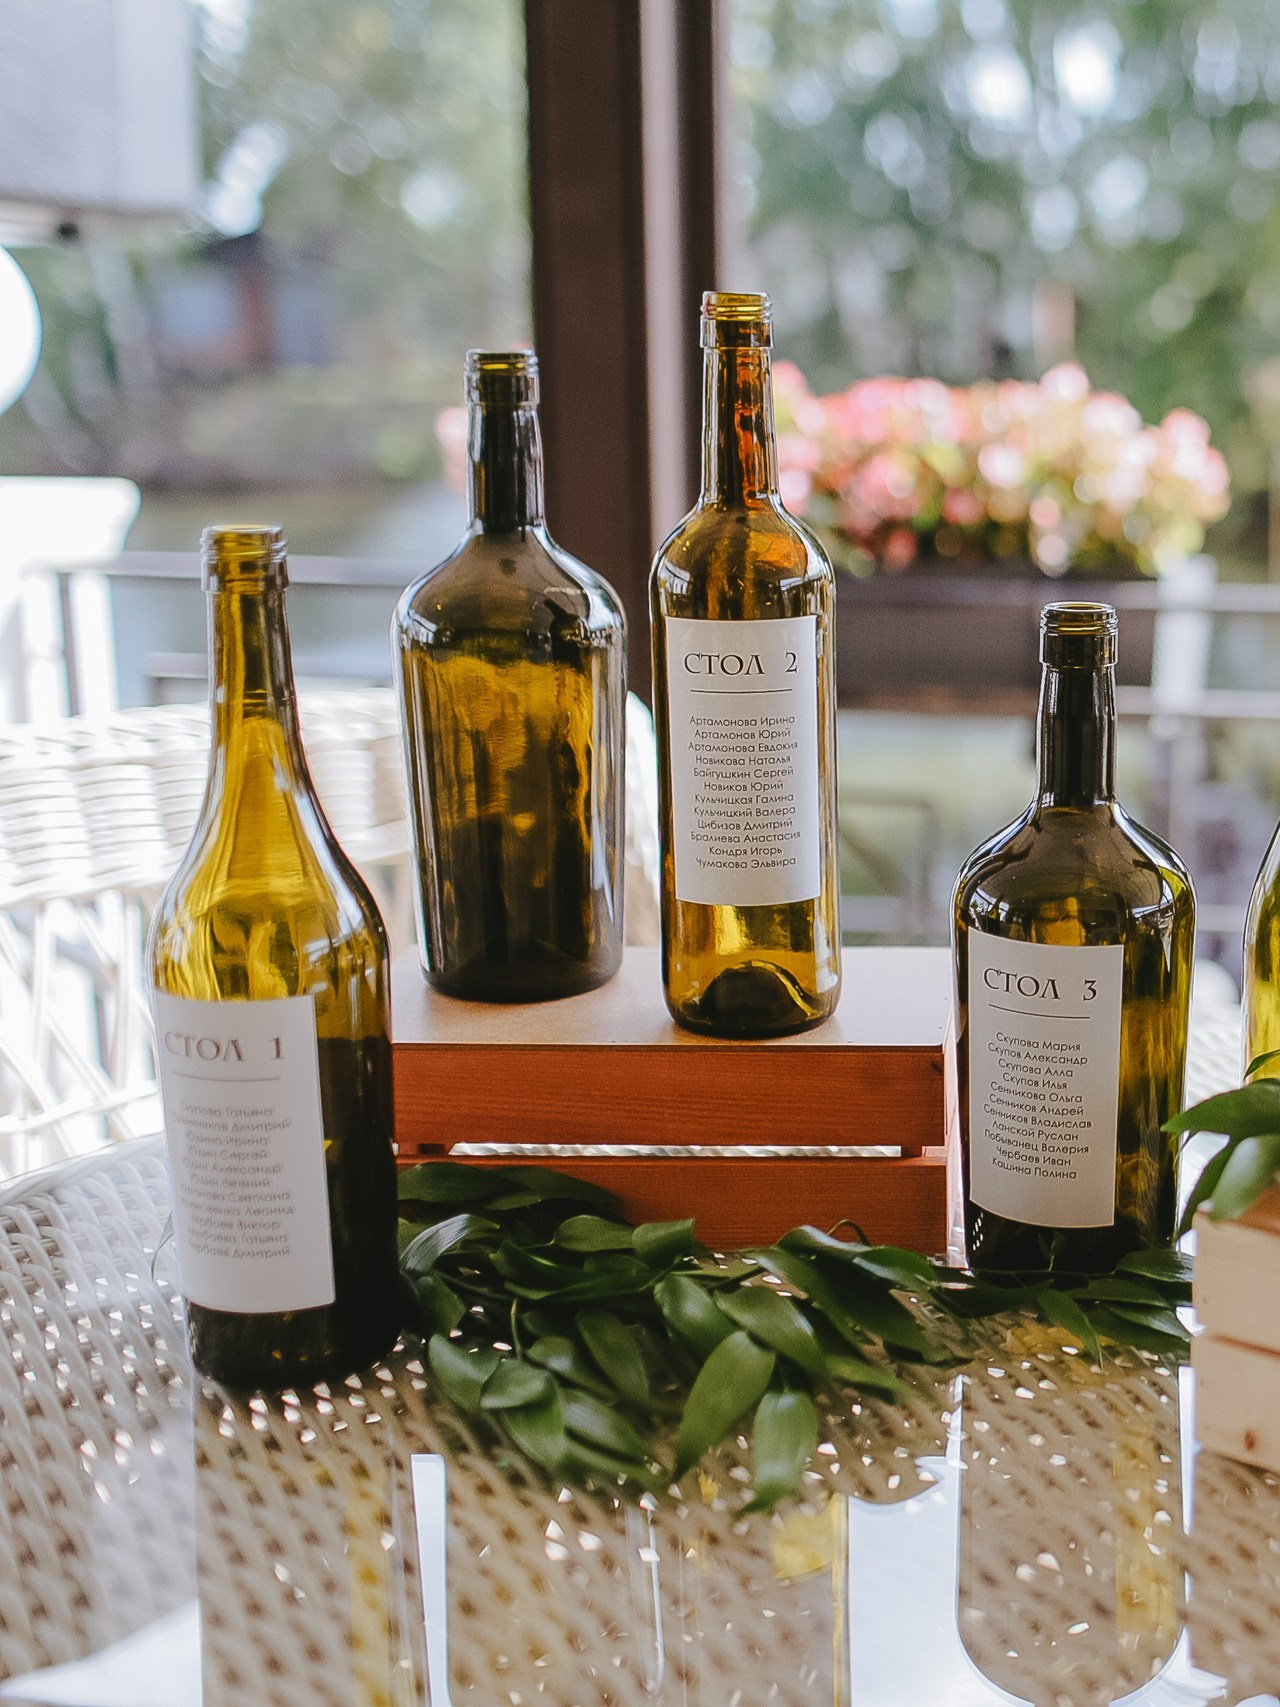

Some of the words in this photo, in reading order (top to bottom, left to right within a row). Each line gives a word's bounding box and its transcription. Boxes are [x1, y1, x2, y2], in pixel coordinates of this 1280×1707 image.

[684, 653, 766, 676] СТОЛ
[785, 652, 798, 673] 2
[689, 716, 757, 727] Артамонова
[760, 716, 795, 727] Ирина
[694, 730, 756, 740] Артамонов
[758, 728, 791, 739] Юрий
[688, 742, 755, 753] Артамонова
[758, 741, 798, 752] Евдокия
[695, 755, 745, 765] Новикова
[749, 756, 791, 765] Наталья
[693, 768, 751, 780] Байгушкин
[753, 766, 794, 778] Сергей
[704, 782, 747, 792] Новиков
[750, 781, 784, 793] Юрий
[694, 793, 753, 805] Кульчицкая
[756, 793, 794, 804] Галина
[693, 806, 753, 818] Кульчицкий
[755, 806, 796, 817] Валера
[697, 820, 740, 830] Цибизов
[743, 818, 793, 831] Дмитрий
[691, 831, 740, 843] Бралиева
[743, 831, 800, 843] Анастасия
[709, 846, 747, 857] Кондря
[750, 846, 782, 856] Игорь
[696, 857, 747, 869] Чумакова
[751, 857, 796, 869] Эльвира
[984, 968, 1061, 1000] СТОЛ
[1082, 979, 1097, 1001] 3
[165, 1031, 245, 1062] СТОЛ
[270, 1035, 284, 1060] 1
[996, 1032, 1039, 1049] Скупова
[1042, 1041, 1080, 1053] Мария
[988, 1042, 1021, 1059] Скупов
[1024, 1052, 1088, 1066] Александр
[998, 1058, 1041, 1075] Скупова
[1045, 1067, 1073, 1077] Алла
[1002, 1072, 1039, 1087] Скупов
[1042, 1079, 1067, 1090] Илья
[990, 1081, 1046, 1101] Сенникова
[1049, 1092, 1083, 1103] Ольга
[989, 1093, 1037, 1112] Сенников
[1039, 1104, 1084, 1117] Андрей
[224, 1107, 273, 1118] Татьяна
[983, 1103, 1028, 1123] Сенников
[1031, 1116, 1092, 1129] Владислав
[231, 1119, 292, 1133] Дмитрий
[992, 1120, 1035, 1138] Ланской
[1037, 1129, 1079, 1142] Руслан
[226, 1137, 269, 1148] Ирина
[984, 1129, 1039, 1152] Побыванец
[1041, 1143, 1089, 1156] Валерия
[221, 1149, 268, 1161] Сергей
[996, 1145, 1040, 1164] Чербаев
[1043, 1155, 1071, 1166] Иван
[211, 1163, 282, 1176] Александр
[1034, 1167, 1077, 1179] Полина
[222, 1177, 271, 1188] Евгений
[228, 1191, 291, 1203] Светлана
[244, 1206, 295, 1216] Леонид
[237, 1219, 281, 1231] Виктор
[241, 1234, 288, 1244] Татьяна
[232, 1245, 290, 1259] Дмитрий
